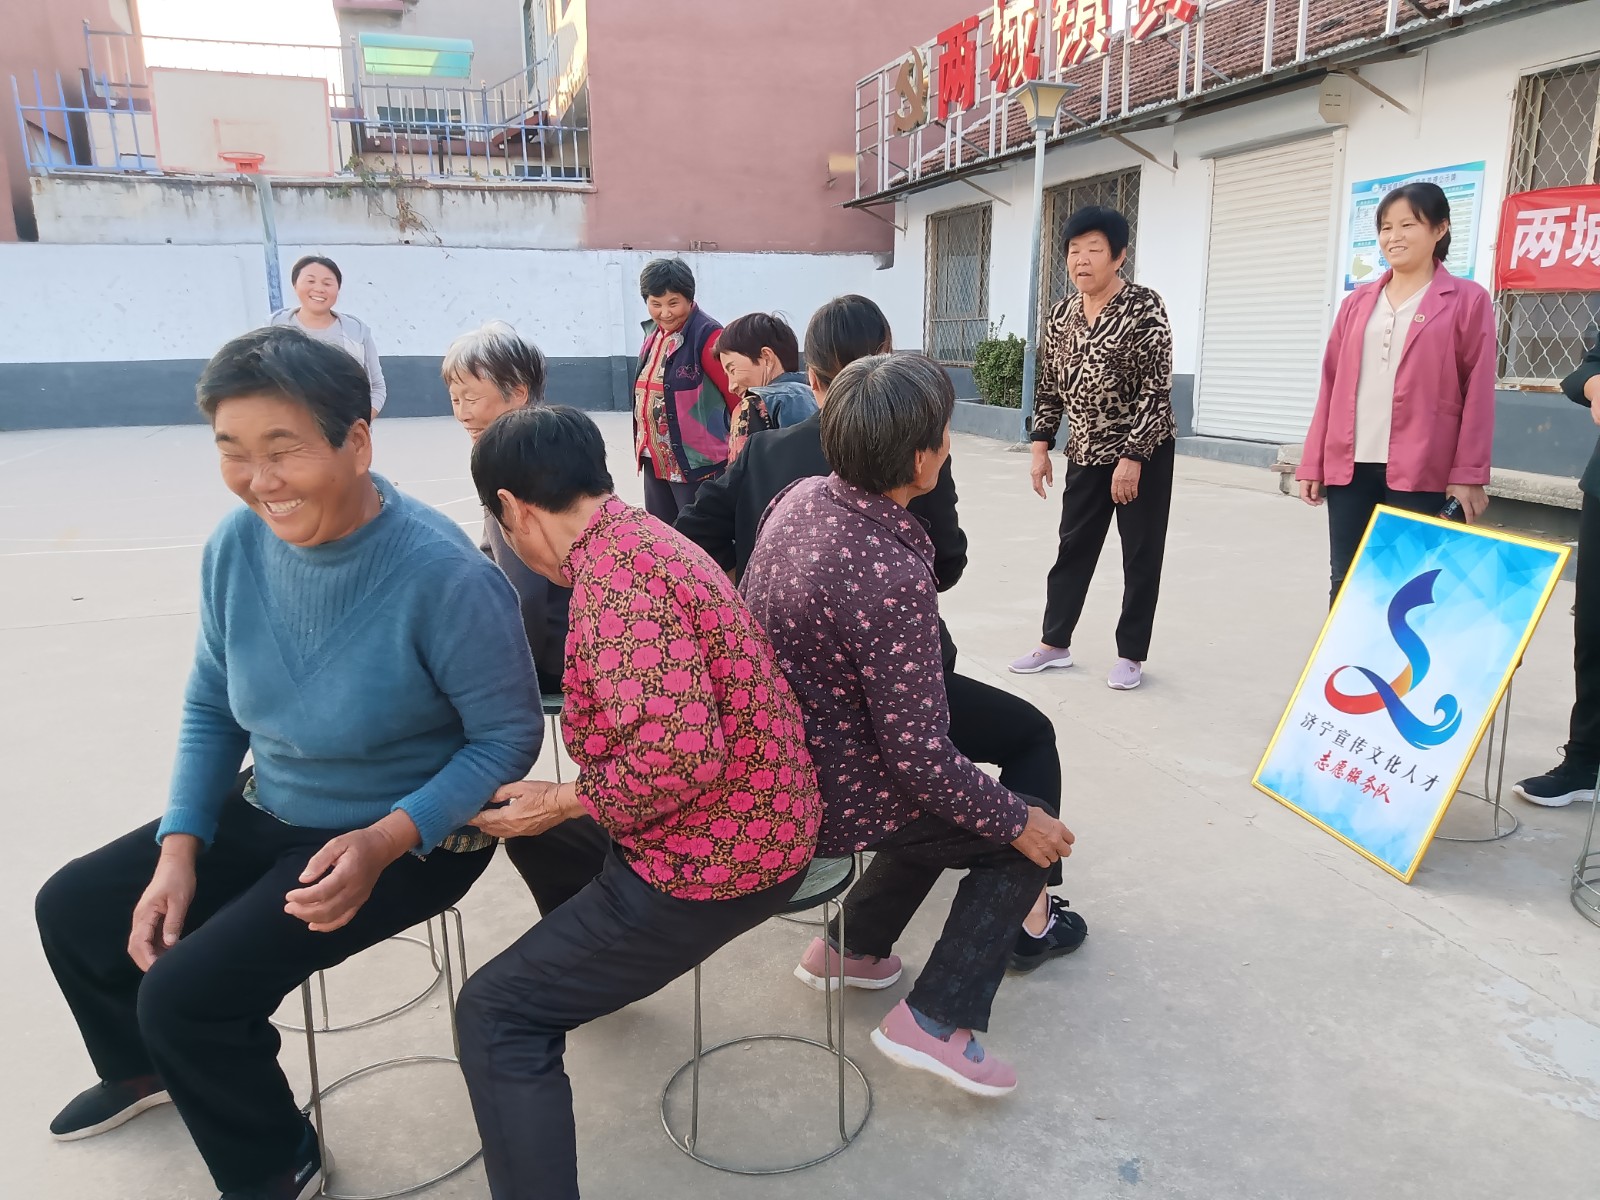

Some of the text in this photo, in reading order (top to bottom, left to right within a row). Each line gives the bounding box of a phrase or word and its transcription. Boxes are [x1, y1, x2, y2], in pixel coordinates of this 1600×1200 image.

[1510, 205, 1600, 269] 两城
[1300, 712, 1440, 792] 济宁宣传文化人才
[1314, 750, 1390, 804] 志愿服务队
